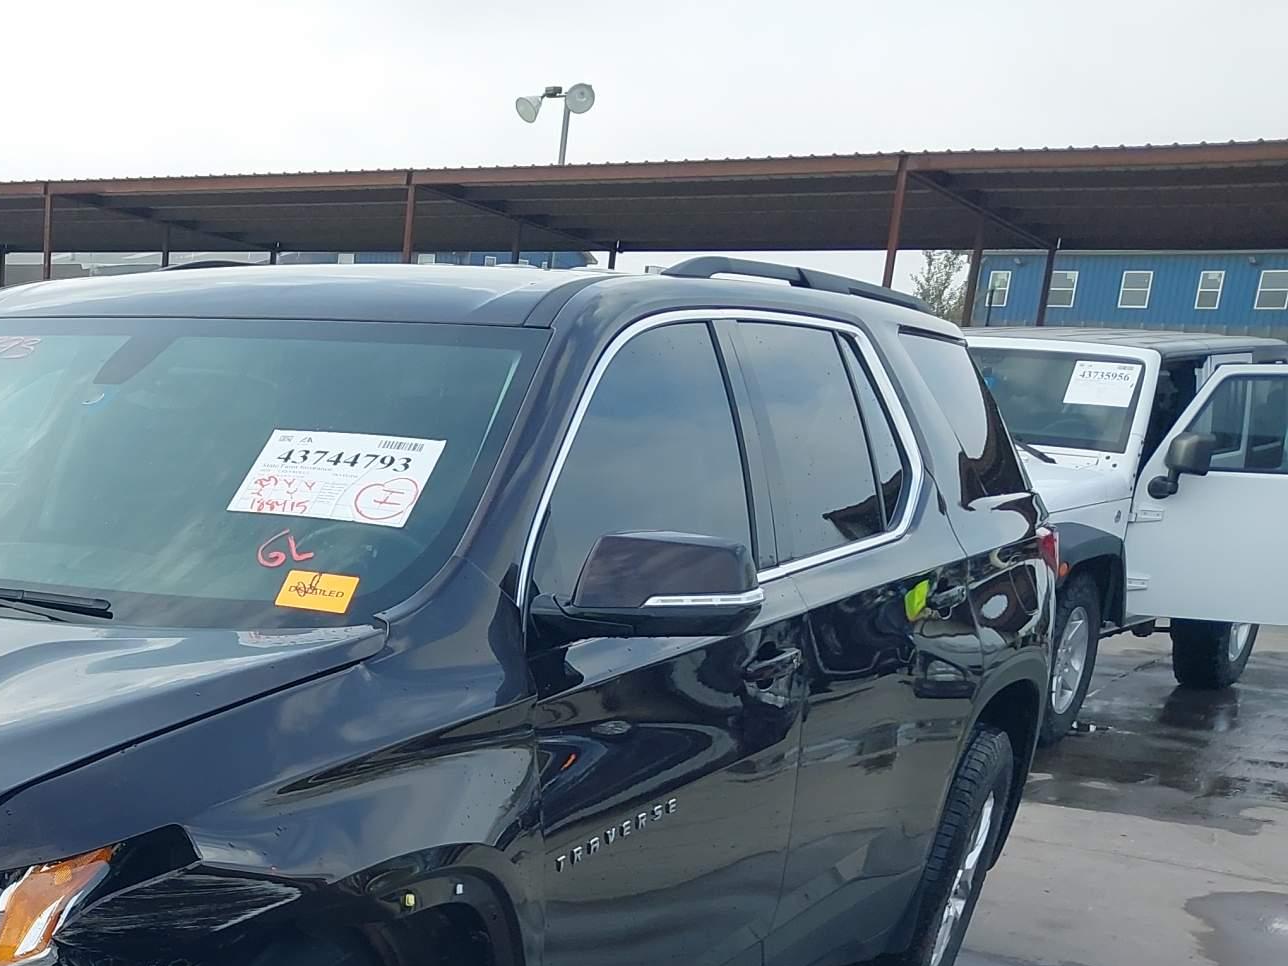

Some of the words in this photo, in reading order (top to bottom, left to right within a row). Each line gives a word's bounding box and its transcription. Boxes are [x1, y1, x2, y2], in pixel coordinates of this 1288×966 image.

[1079, 370, 1130, 382] 43735956
[276, 448, 413, 473] 43744793
[555, 797, 678, 873] TRAVERSE
